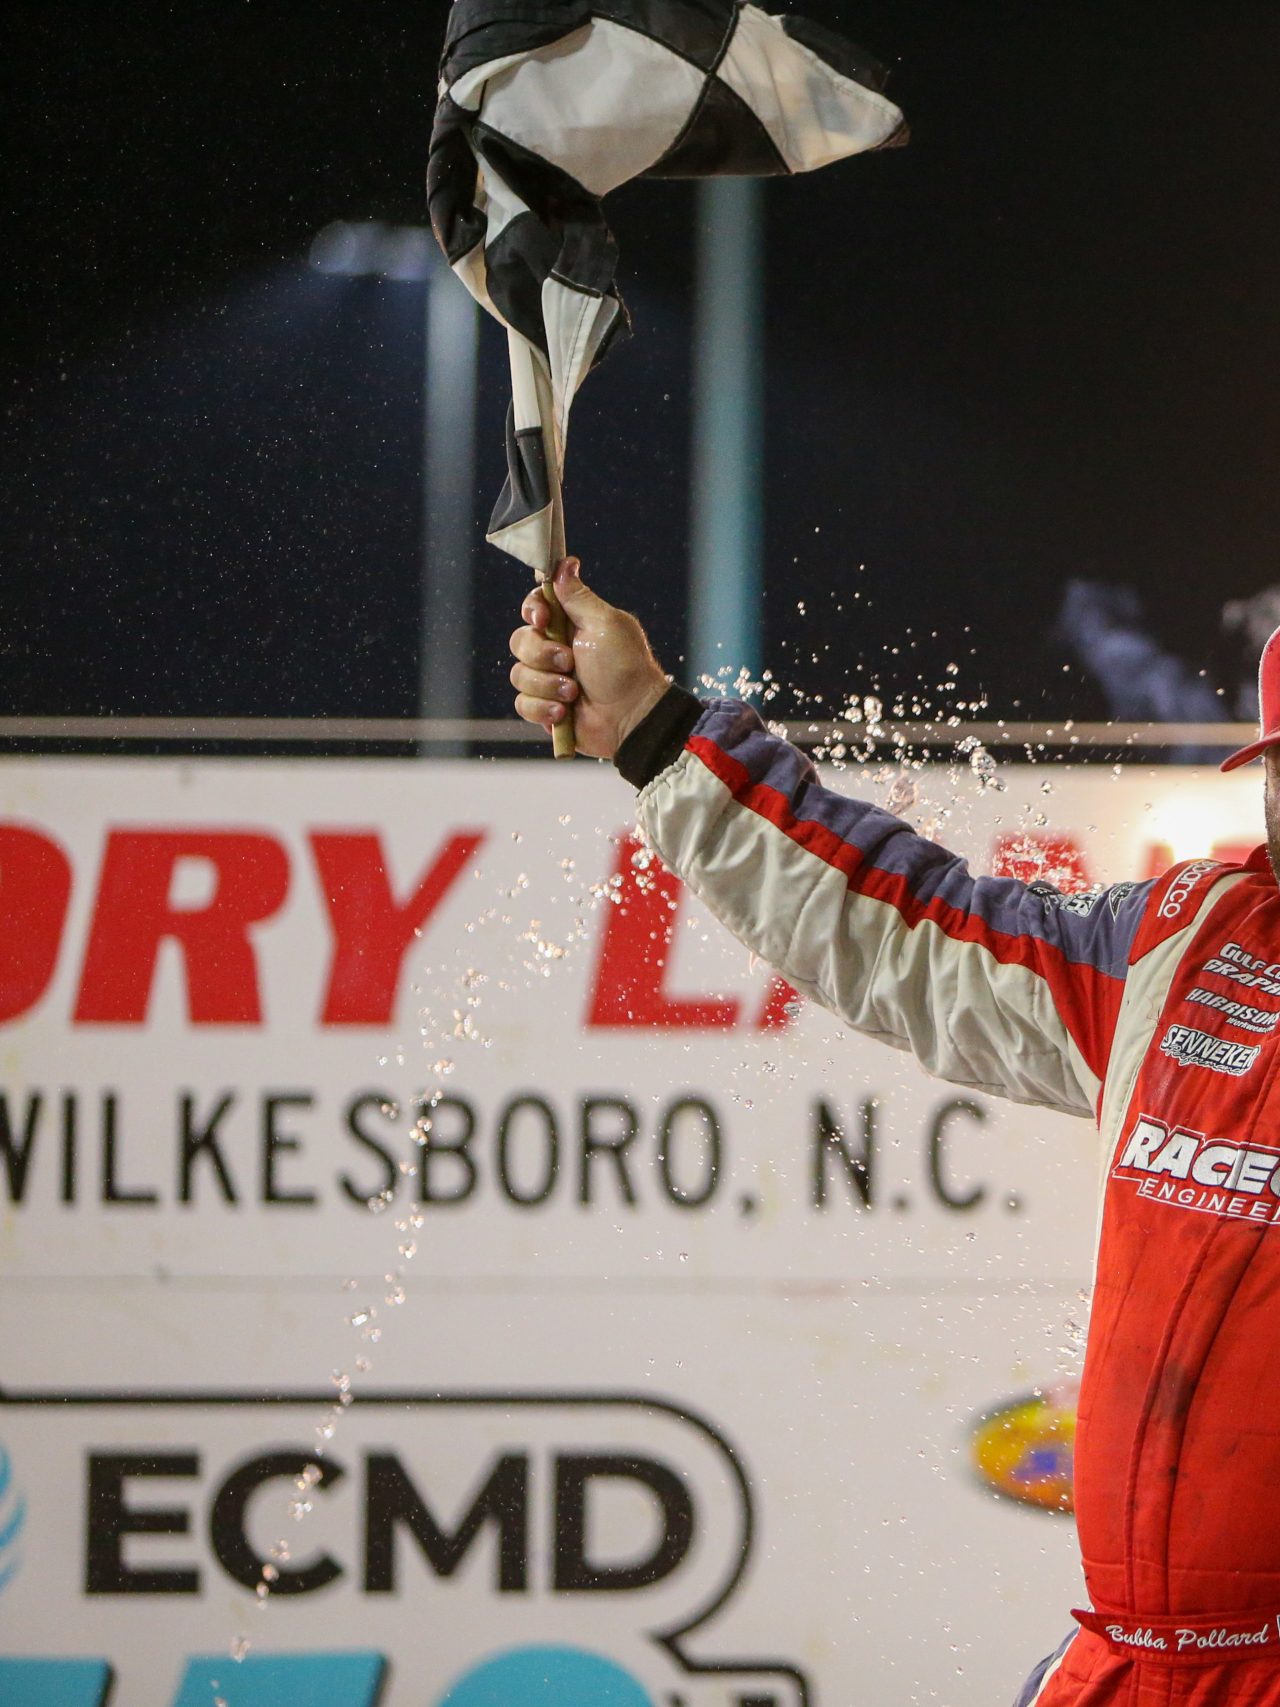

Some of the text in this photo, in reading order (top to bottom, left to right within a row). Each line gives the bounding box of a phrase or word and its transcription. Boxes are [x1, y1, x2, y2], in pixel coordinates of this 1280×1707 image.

[1157, 859, 1221, 918] parco
[1220, 942, 1266, 970] GULF
[811, 1095, 1022, 1210] N.C.
[84, 1450, 694, 1596] ECMD
[1105, 1624, 1269, 1651] Bubba Pollard
